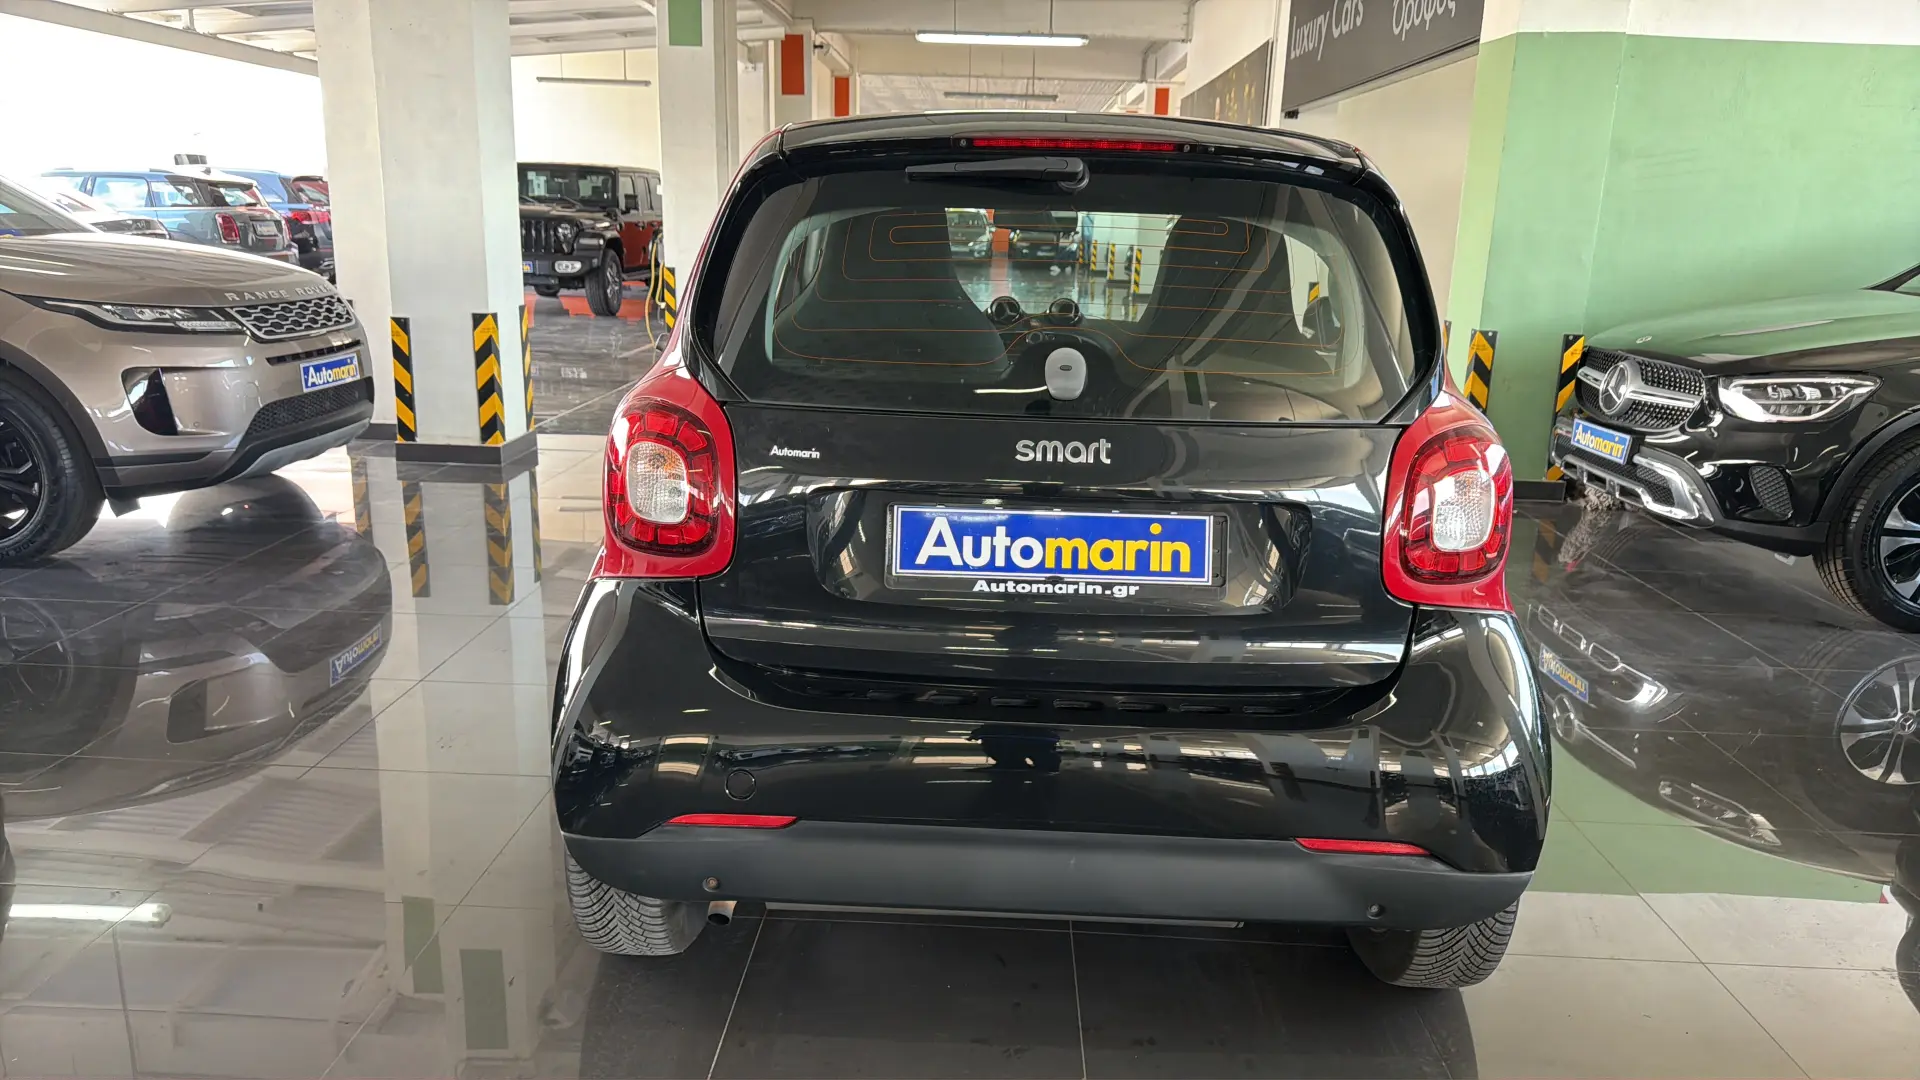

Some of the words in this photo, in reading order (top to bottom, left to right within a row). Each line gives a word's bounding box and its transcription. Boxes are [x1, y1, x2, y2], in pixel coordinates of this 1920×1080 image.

[1290, 11, 1330, 61] Luxury
[1332, 0, 1364, 39] Cars
[224, 289, 290, 301] RANGE
[307, 360, 357, 387] Automarin
[769, 444, 820, 459] Automarin
[1015, 438, 1111, 464] smart
[1574, 423, 1625, 459] Automarin
[914, 516, 1191, 573] Automarin
[972, 579, 1140, 598] Automarin.gr
